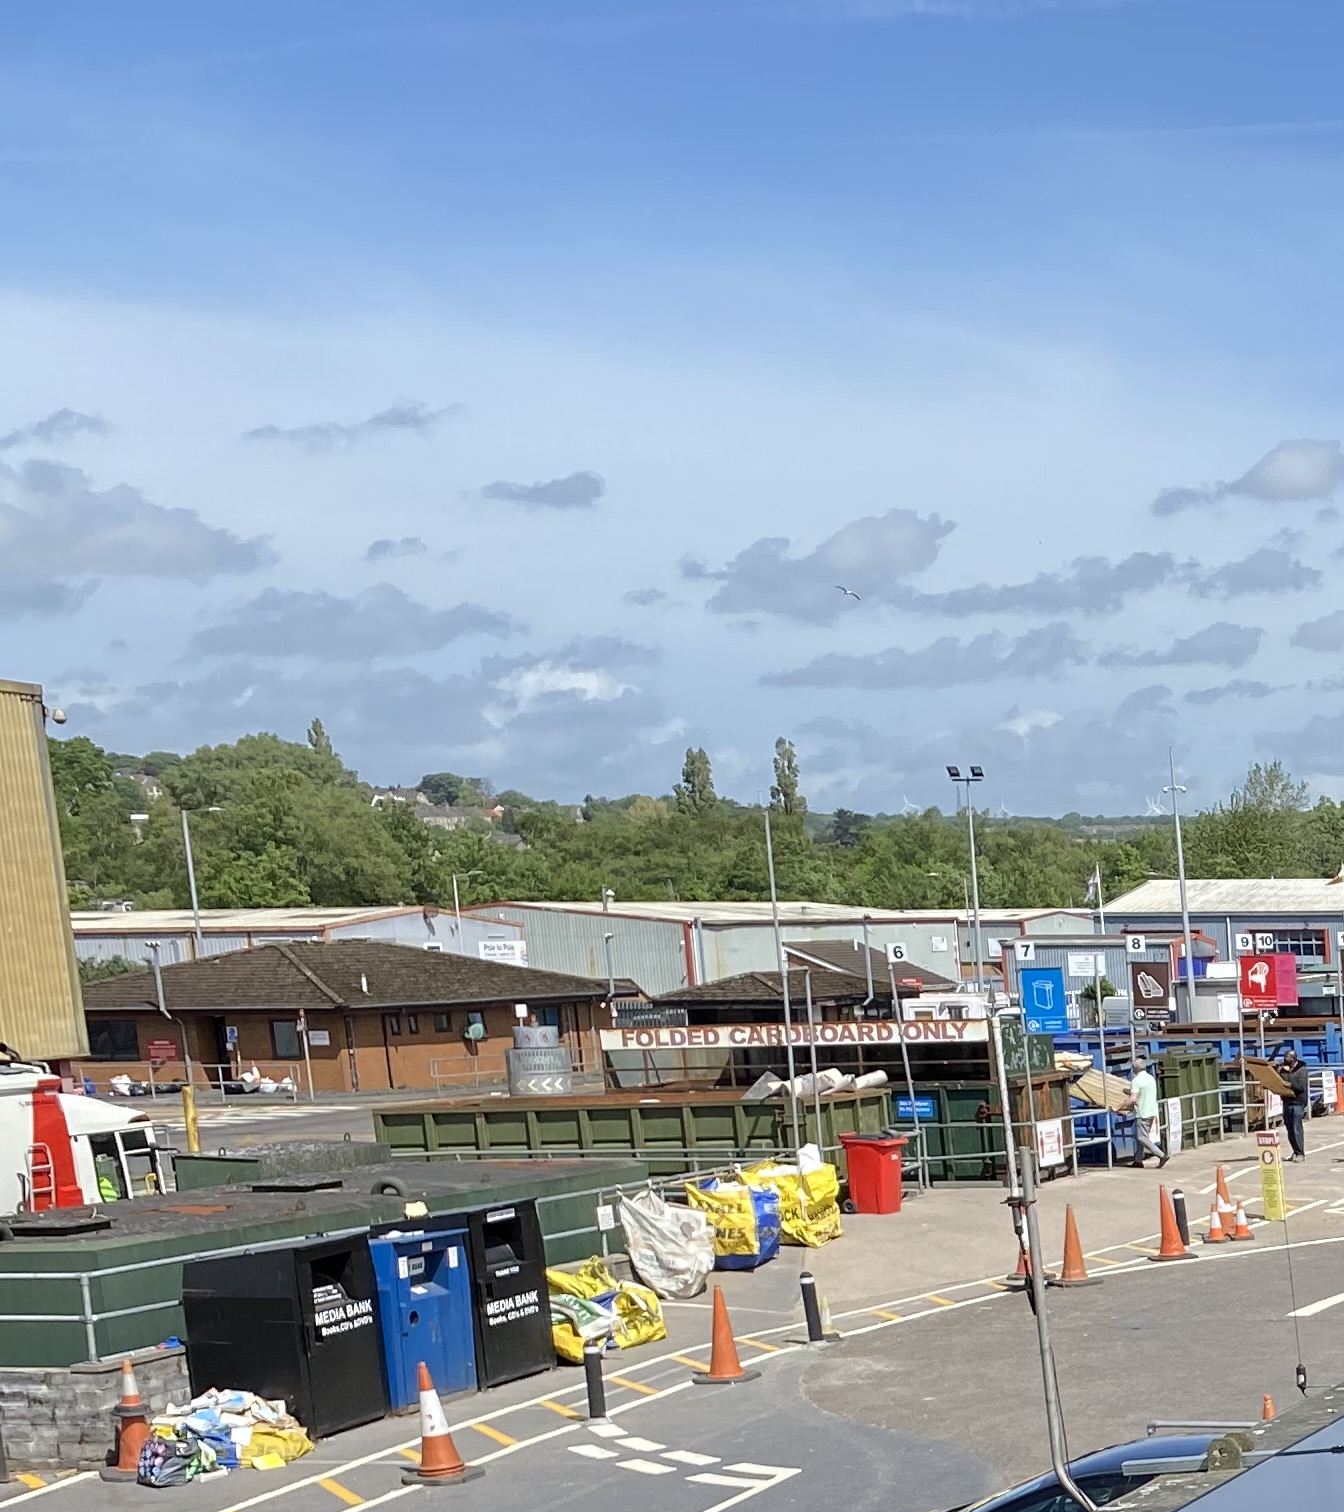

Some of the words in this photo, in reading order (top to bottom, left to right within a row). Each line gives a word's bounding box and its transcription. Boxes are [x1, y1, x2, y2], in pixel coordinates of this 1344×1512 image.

[1131, 937, 1141, 950] 8
[1240, 936, 1249, 947] 9
[1258, 935, 1272, 946] 10
[893, 945, 904, 959] 6
[1020, 944, 1031, 957] 7
[621, 1027, 721, 1047] FOLDED
[728, 1022, 894, 1046] CARDBOARD
[902, 1021, 968, 1041] ONLY
[486, 1298, 515, 1316] MEDIA
[514, 1290, 539, 1308] BANK
[314, 1306, 346, 1327] MEDIA
[345, 1298, 373, 1318] BANK
